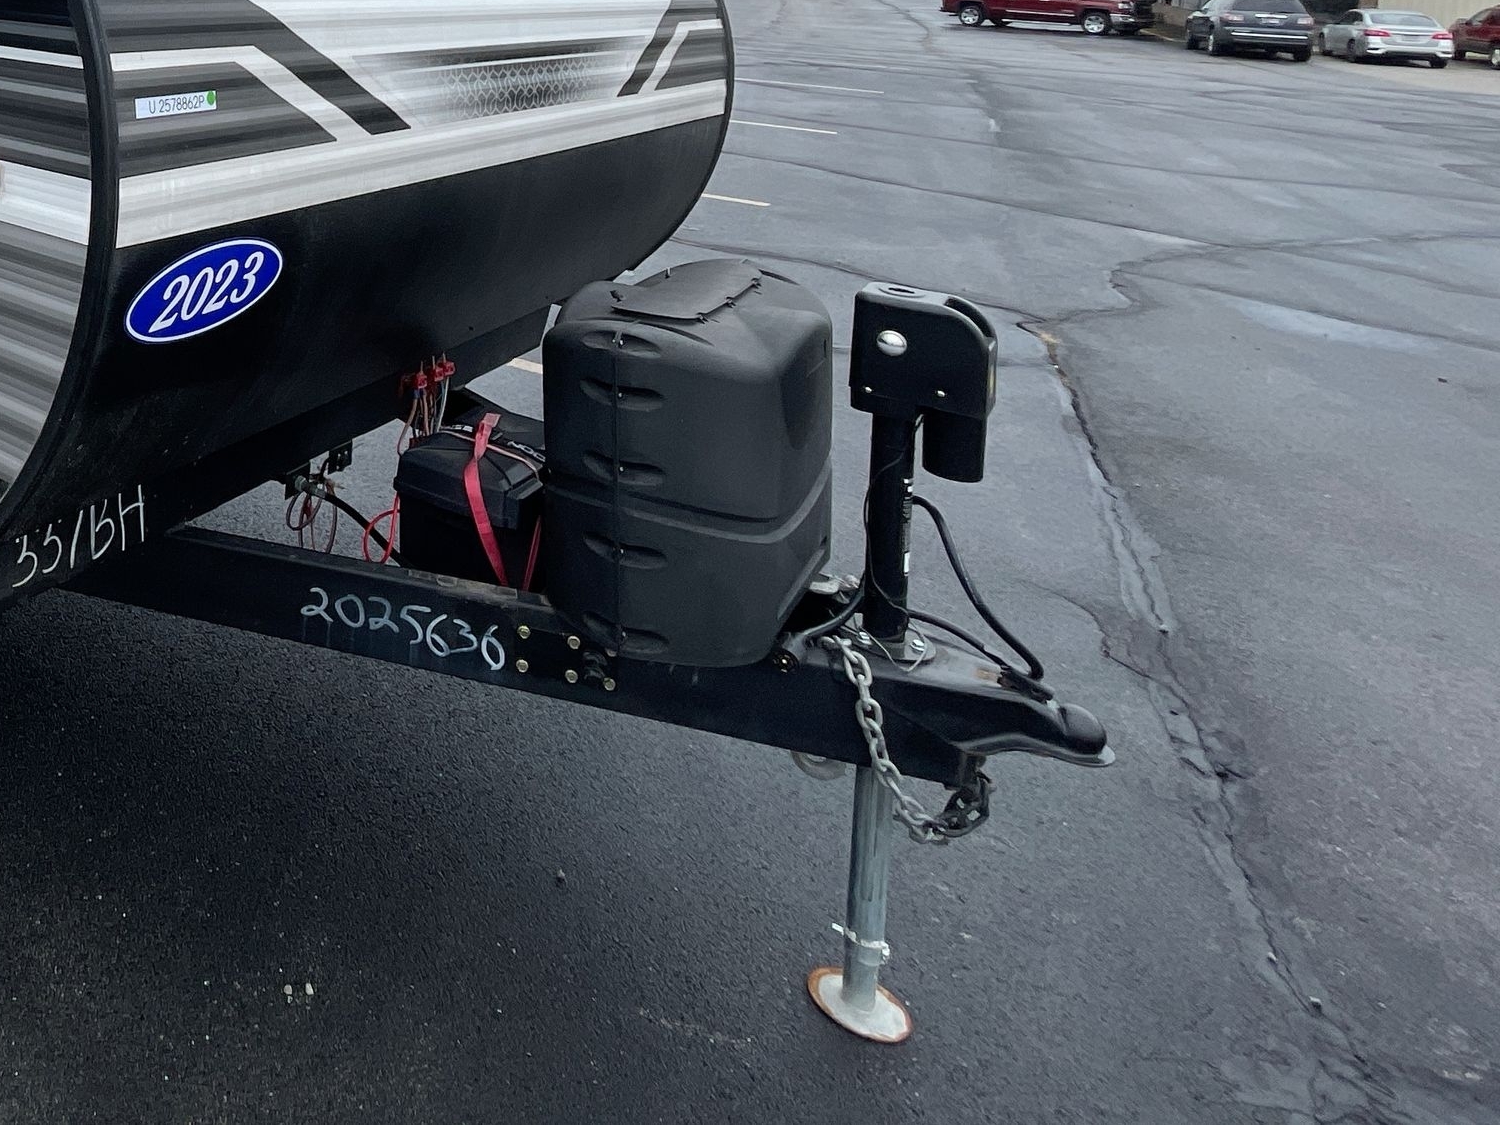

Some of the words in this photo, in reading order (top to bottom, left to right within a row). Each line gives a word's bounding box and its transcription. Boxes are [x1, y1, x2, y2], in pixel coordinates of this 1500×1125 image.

[147, 99, 157, 115] U
[158, 94, 206, 113] 2578862P
[148, 250, 265, 334] 2023
[299, 586, 506, 671] 2025636
